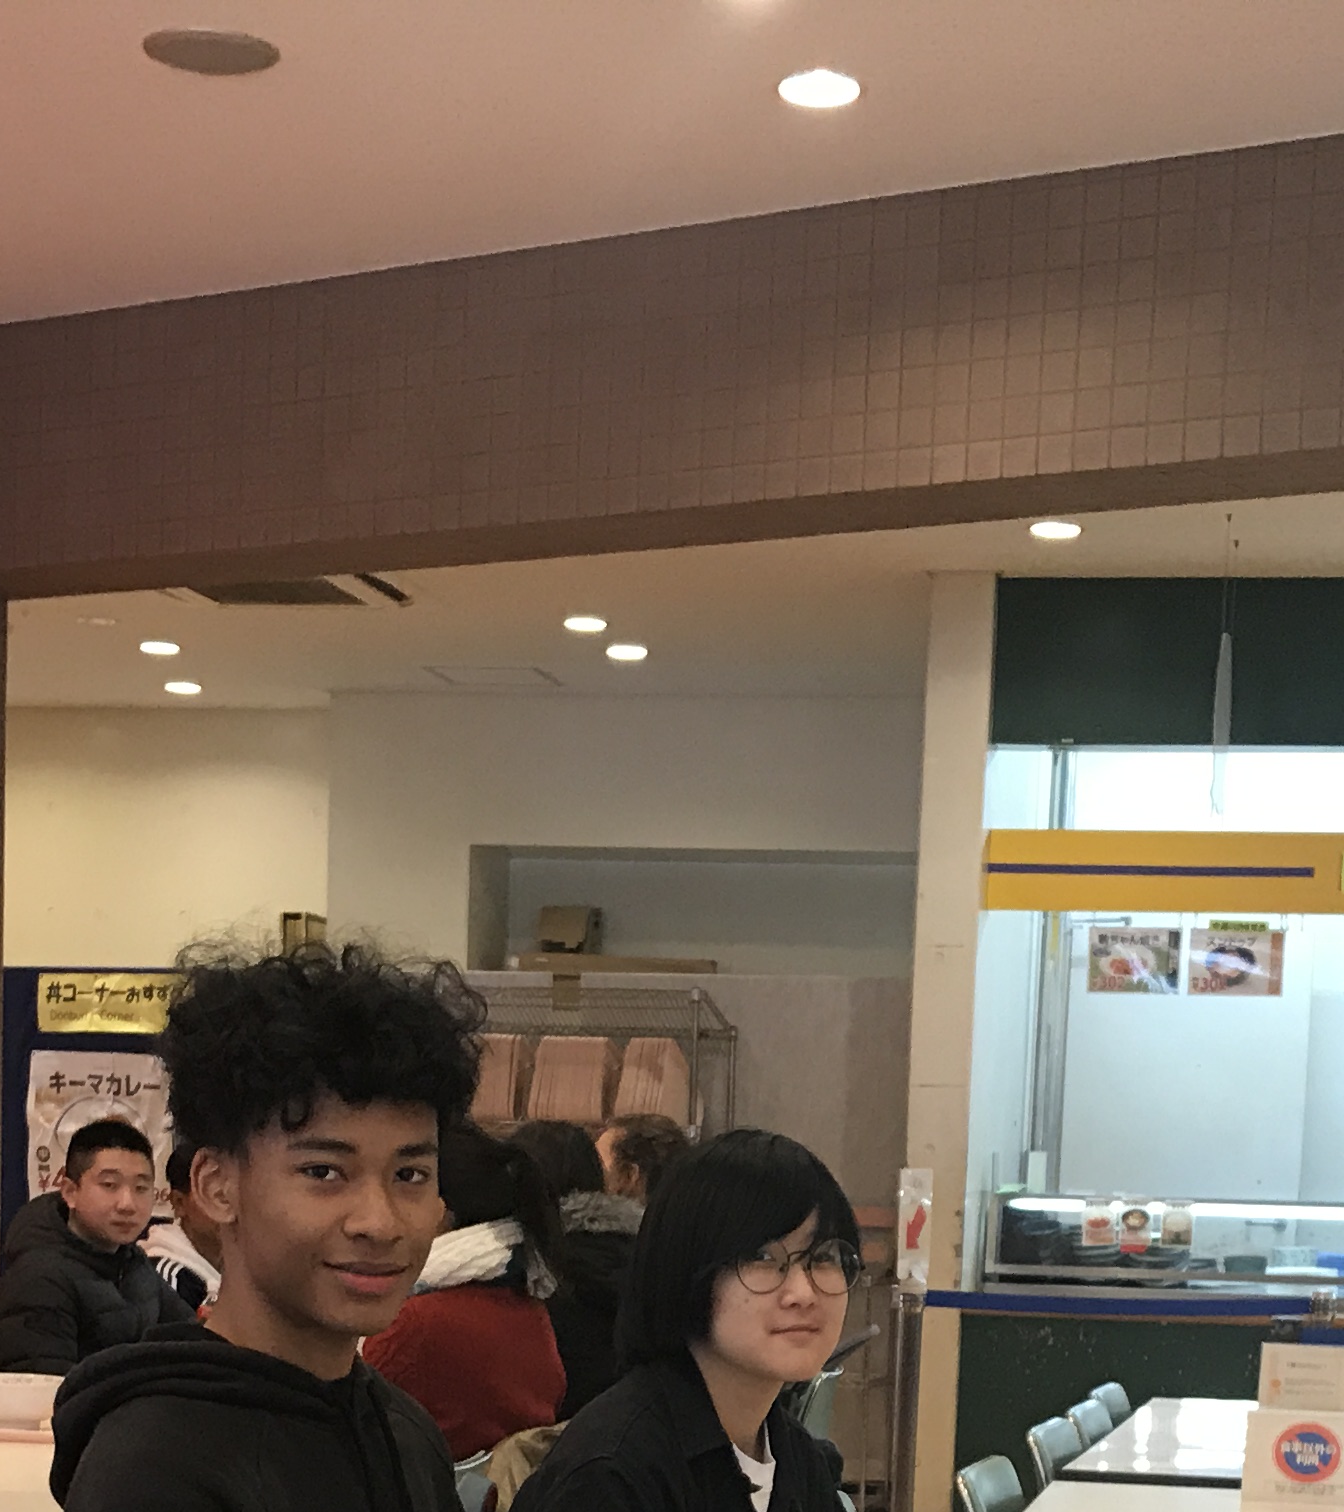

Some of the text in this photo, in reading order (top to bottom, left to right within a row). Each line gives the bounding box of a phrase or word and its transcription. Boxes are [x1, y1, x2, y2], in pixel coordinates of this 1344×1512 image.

[48, 1070, 162, 1097] キーマカレー
